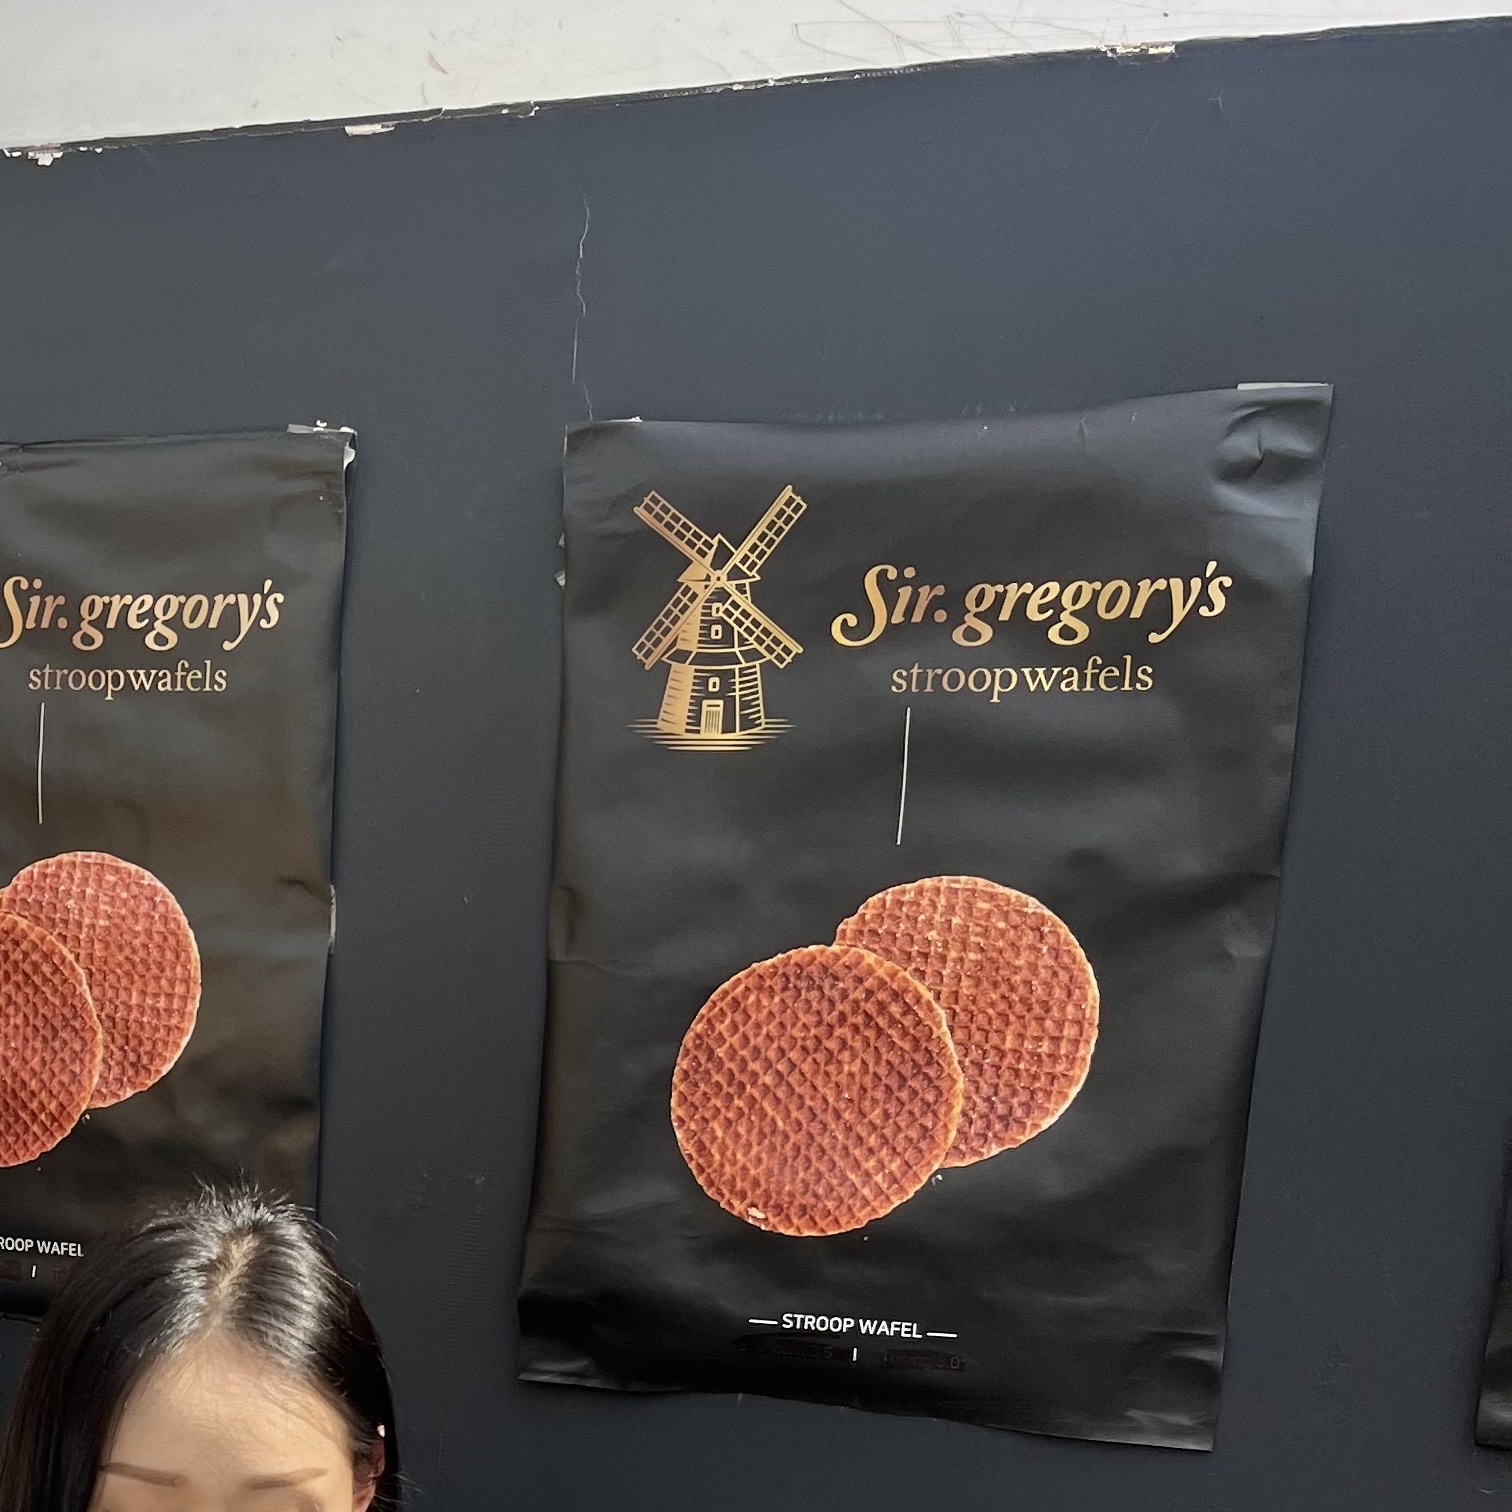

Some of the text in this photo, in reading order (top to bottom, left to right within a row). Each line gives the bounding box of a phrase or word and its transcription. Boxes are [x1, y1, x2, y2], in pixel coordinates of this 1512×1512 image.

[72, 578, 285, 651] gregory's
[830, 560, 1233, 647] Sir. gregory's
[28, 659, 227, 701] stroopwafels
[890, 654, 1153, 703] stroopwafels
[36, 1239, 85, 1258] WAFEL
[781, 1313, 923, 1339] STROOP WAFEL
